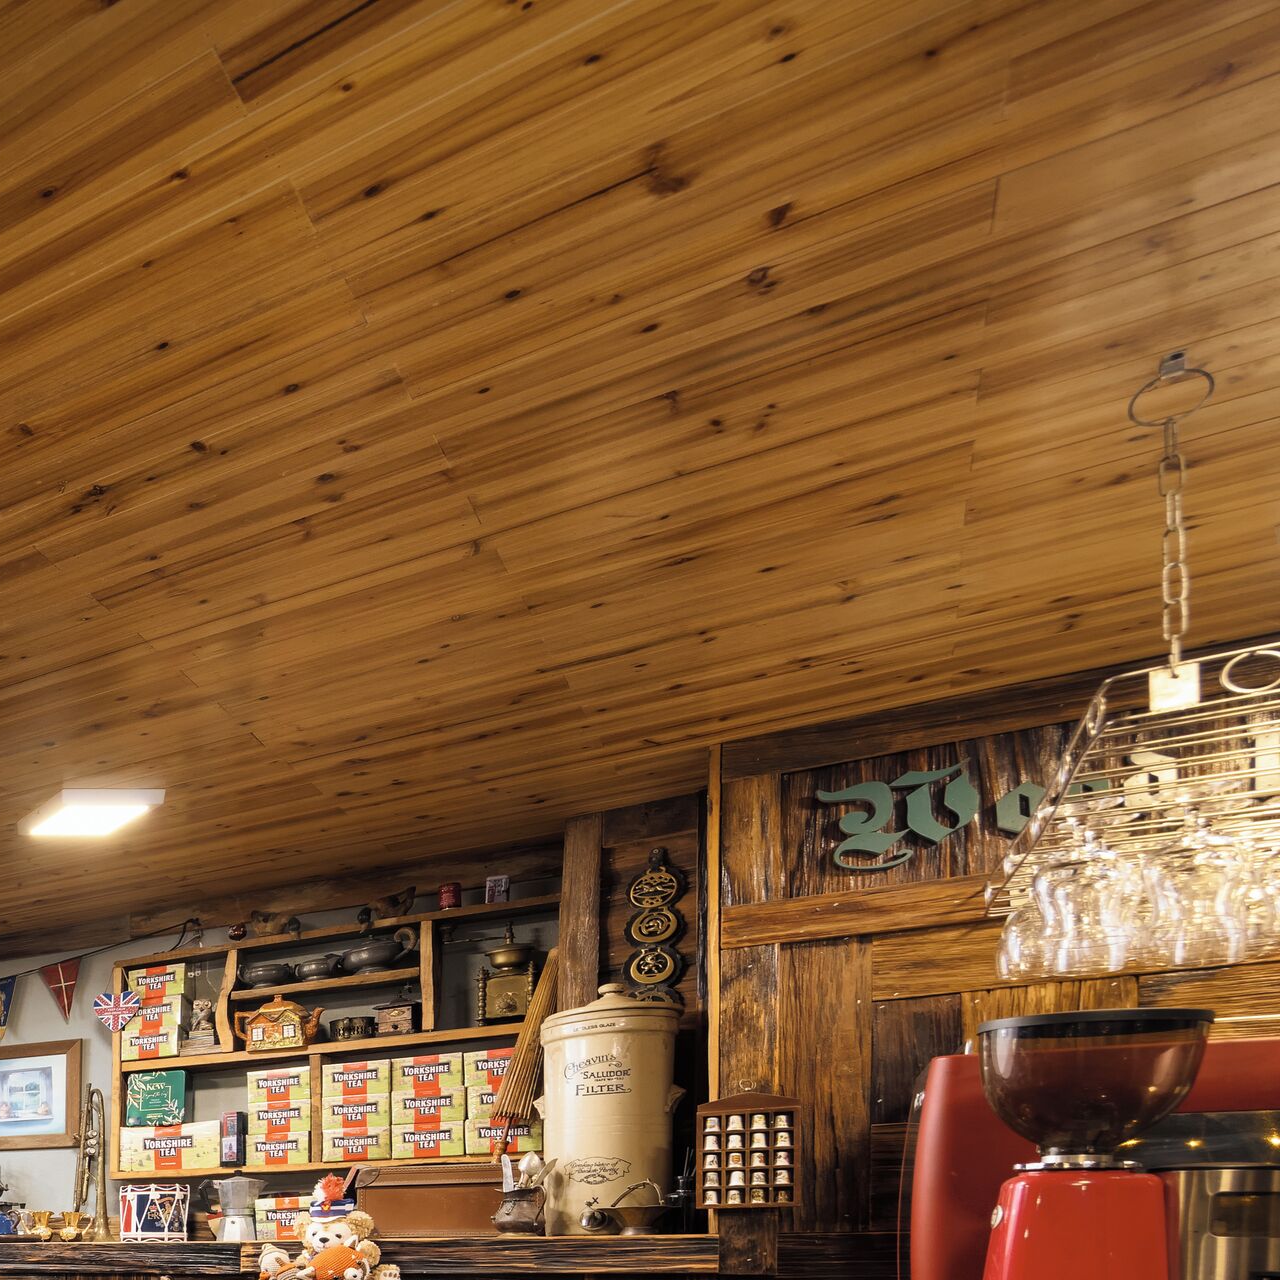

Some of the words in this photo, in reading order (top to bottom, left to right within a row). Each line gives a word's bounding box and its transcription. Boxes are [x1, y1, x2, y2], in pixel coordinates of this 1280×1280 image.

[138, 974, 175, 986] YORKSHIRE
[149, 982, 162, 990] TEA
[131, 1035, 168, 1046] YORKSHIRE
[477, 1059, 511, 1070] YORKSH
[404, 1065, 449, 1076] YORKSHIRE
[334, 1071, 377, 1082] YORKSHIRE
[418, 1073, 434, 1082] TEA
[258, 1077, 299, 1088] YORKSHIRE
[348, 1080, 362, 1088] TEA
[575, 1083, 629, 1096] FILTER
[405, 1098, 451, 1108] YORKSHIRE
[259, 1110, 300, 1120] YORKSHIRE
[333, 1104, 377, 1115] YORKSHIRE
[420, 1106, 435, 1115] TEA
[347, 1113, 361, 1121] TEA
[404, 1131, 450, 1142] YORKSHIRE
[480, 1127, 529, 1138] YORKHIRE
[144, 1138, 192, 1149] YORKSHIRE
[256, 1142, 297, 1152] YORKSHIRE
[334, 1137, 378, 1148] YORKSHIRE
[419, 1140, 435, 1149] TEA
[160, 1148, 176, 1157] TEA
